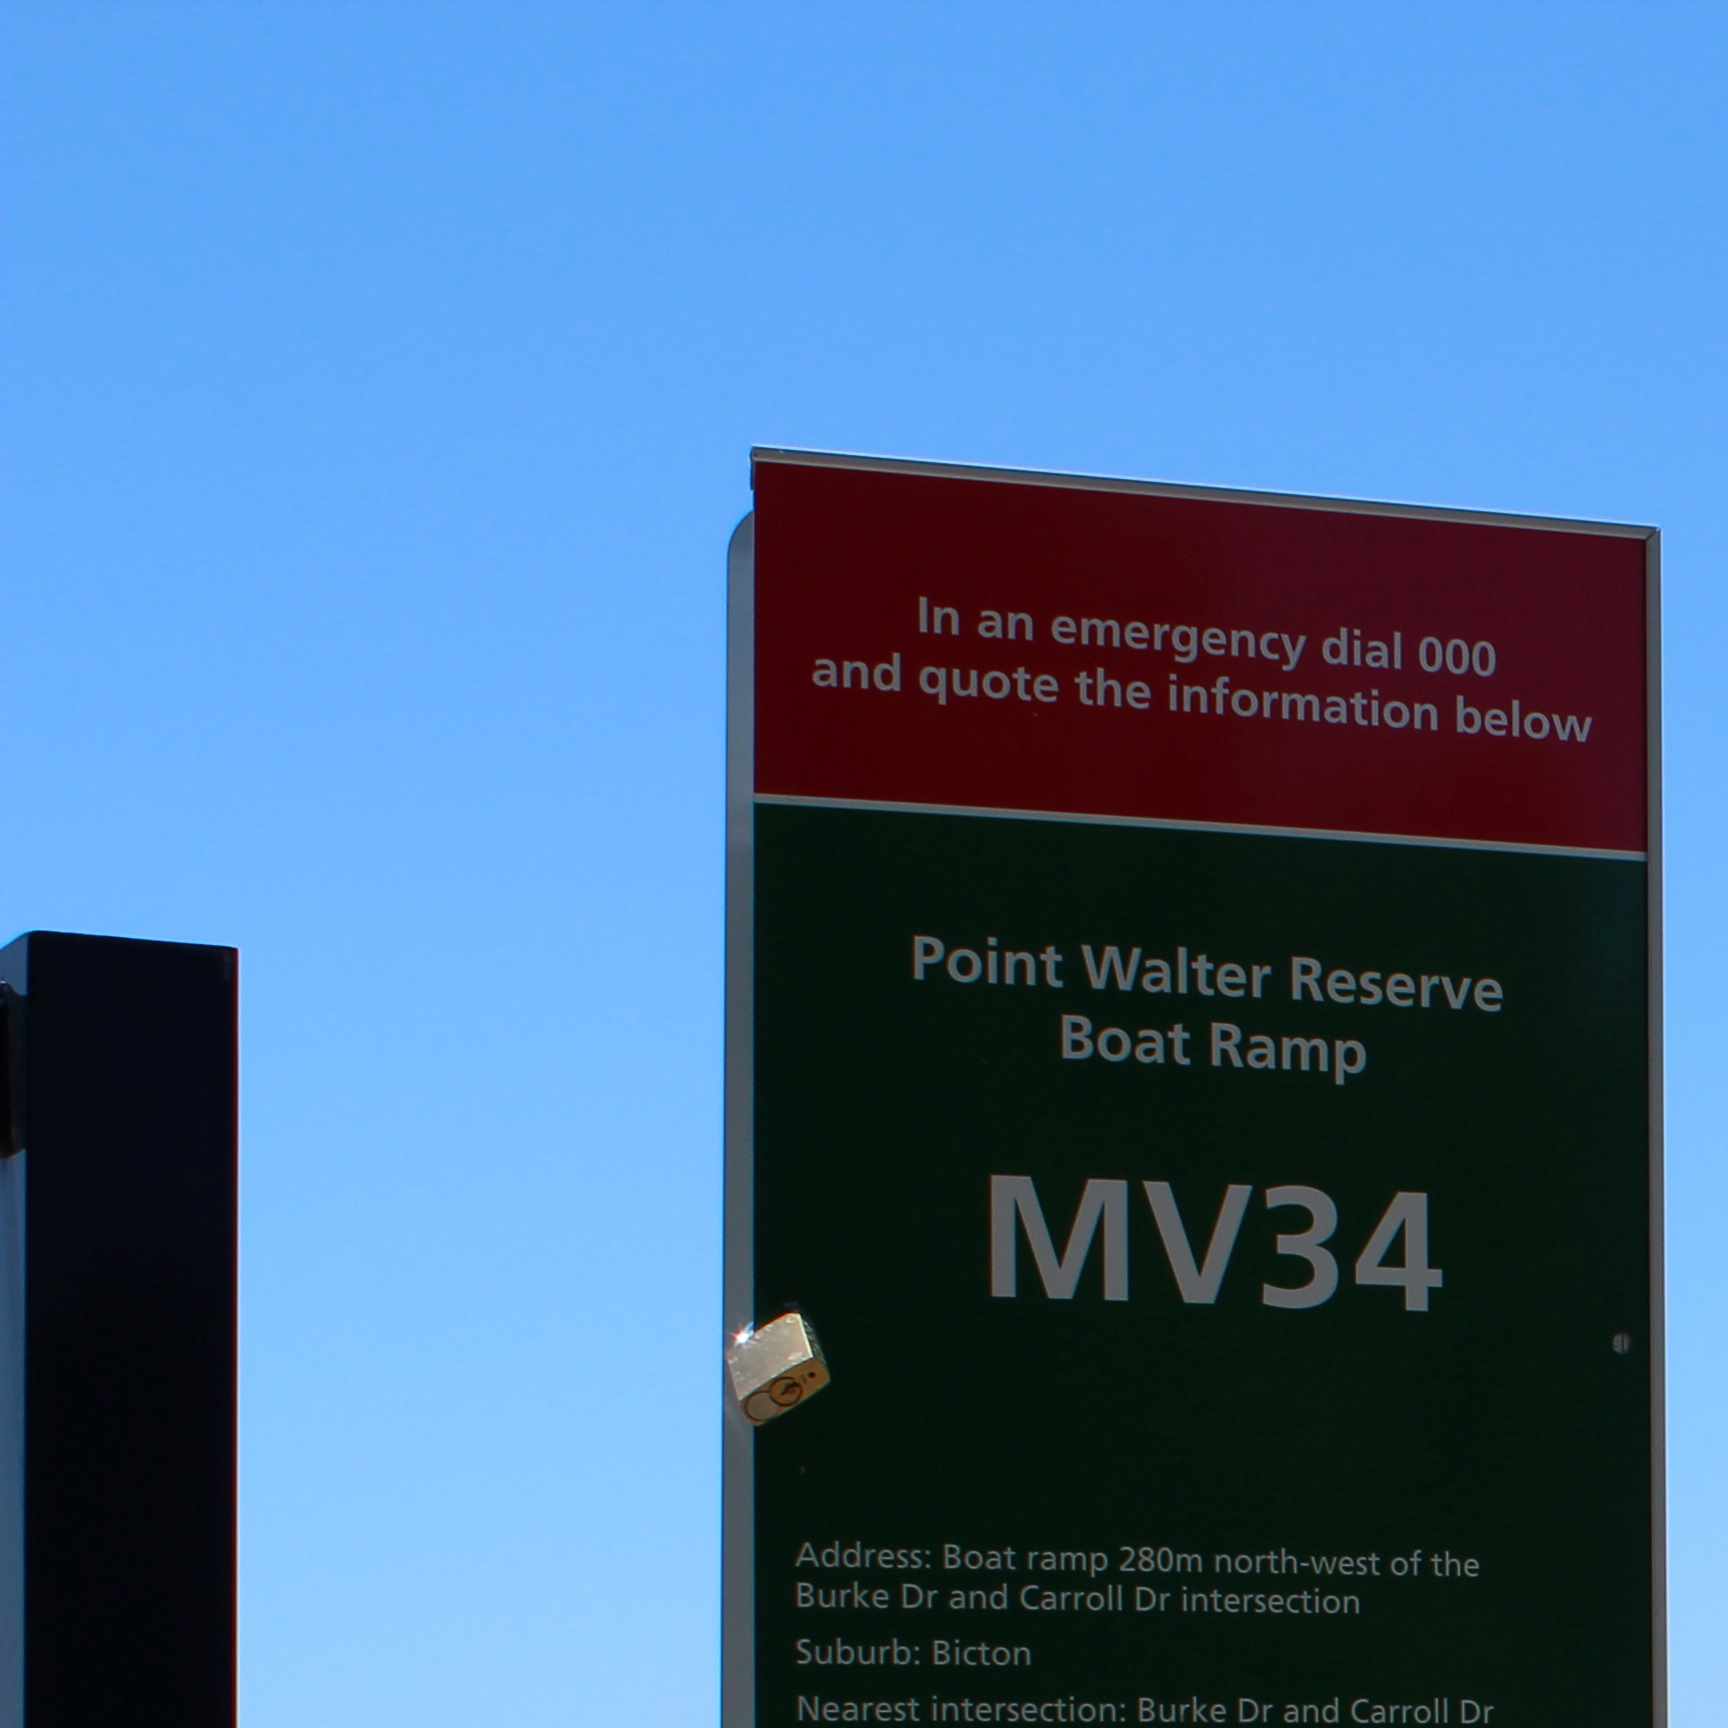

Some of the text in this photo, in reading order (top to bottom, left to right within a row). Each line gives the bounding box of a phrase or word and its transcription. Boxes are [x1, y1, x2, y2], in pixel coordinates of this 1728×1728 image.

[919, 596, 1495, 676] In an emergency dial 000
[812, 652, 1592, 742] and quote the information below
[914, 936, 1503, 1012] Point Walter Reserve
[1062, 1015, 1366, 1085] Boat Ramp
[991, 1175, 1442, 1311] MV34
[795, 1541, 1479, 1577] Address: Boat ramp 280m north-west of the
[797, 1581, 1359, 1614] Burke Dr and Carroll Dr intersection
[797, 1638, 1030, 1666] Suburb: Bicton
[798, 1696, 1494, 1724] Nearest intersection: Burke Dr and Carroll Dr
